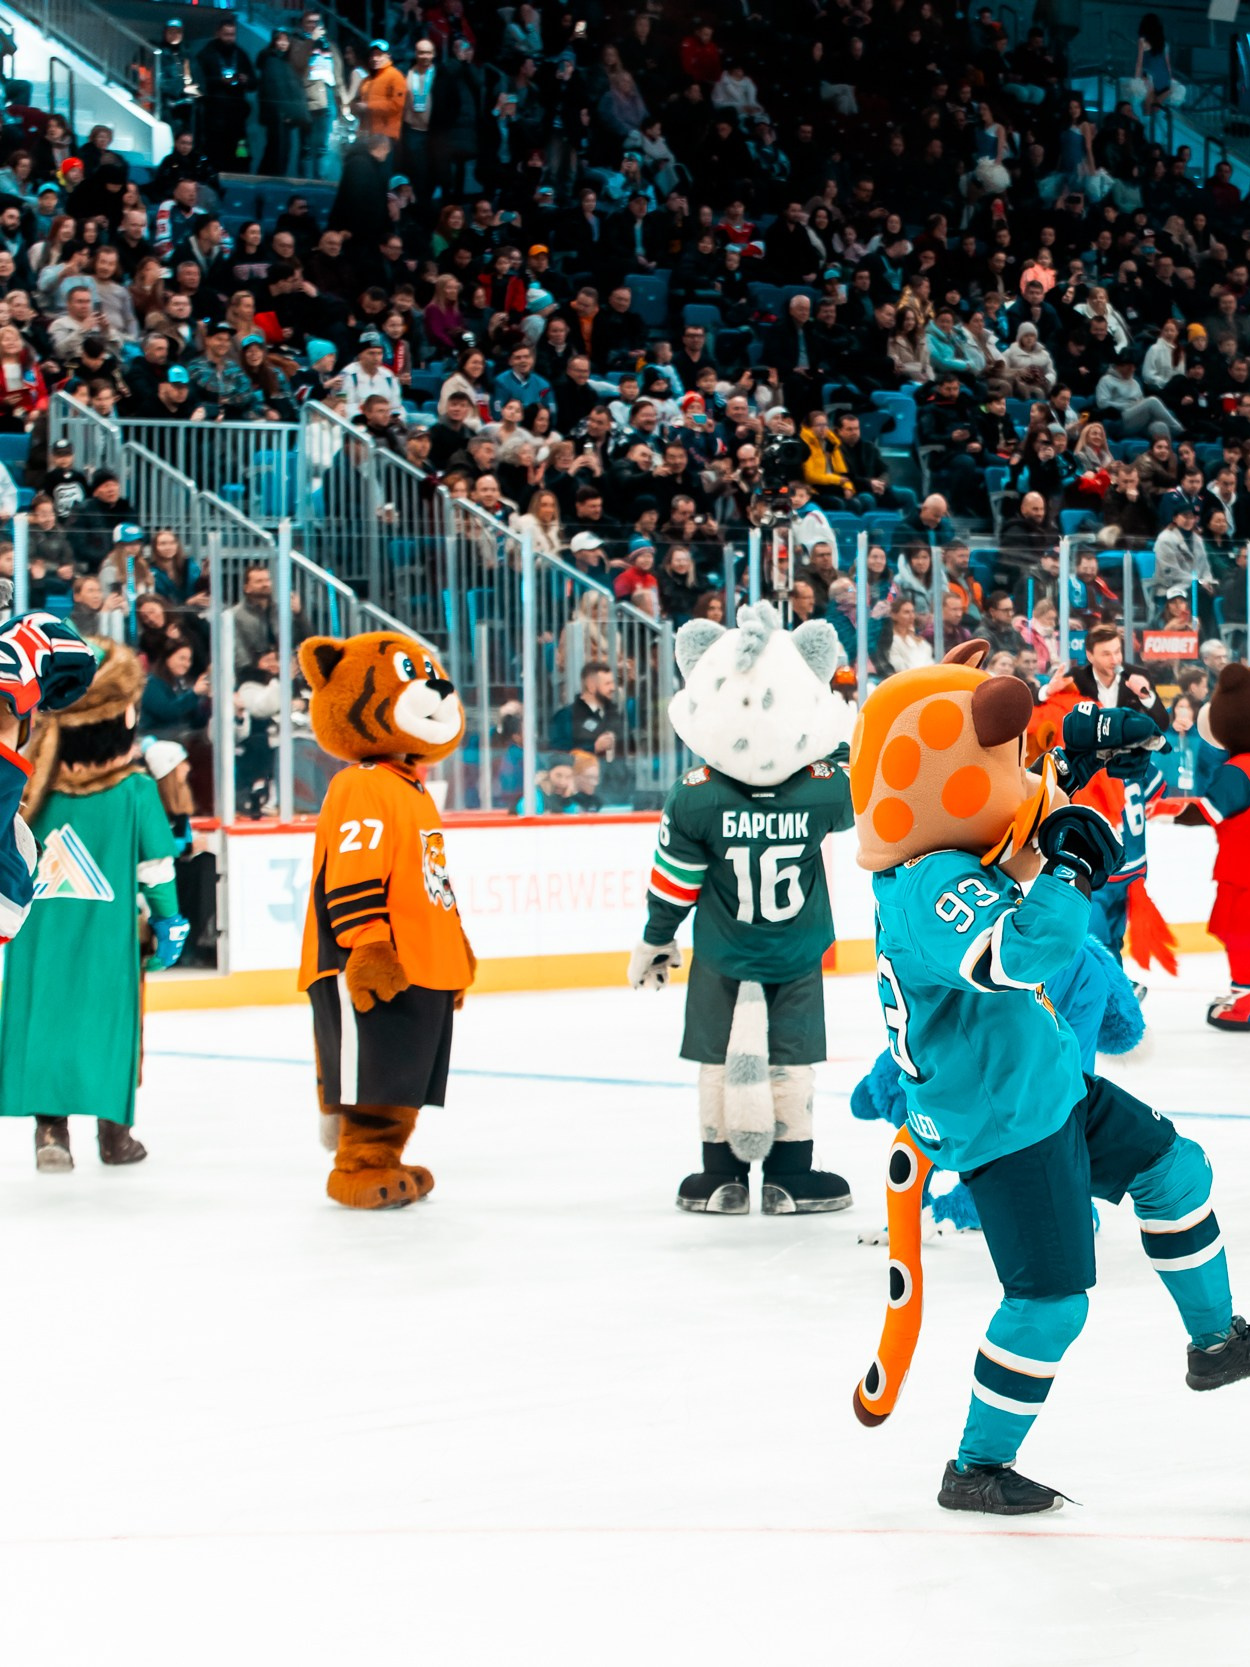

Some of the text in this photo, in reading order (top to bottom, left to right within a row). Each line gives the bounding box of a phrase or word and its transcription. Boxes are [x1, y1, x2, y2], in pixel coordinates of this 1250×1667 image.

[1144, 636, 1197, 653] FONBET
[338, 818, 385, 853] 27
[722, 811, 809, 839] БАРСИК
[725, 844, 806, 925] 16
[934, 878, 1000, 934] 93
